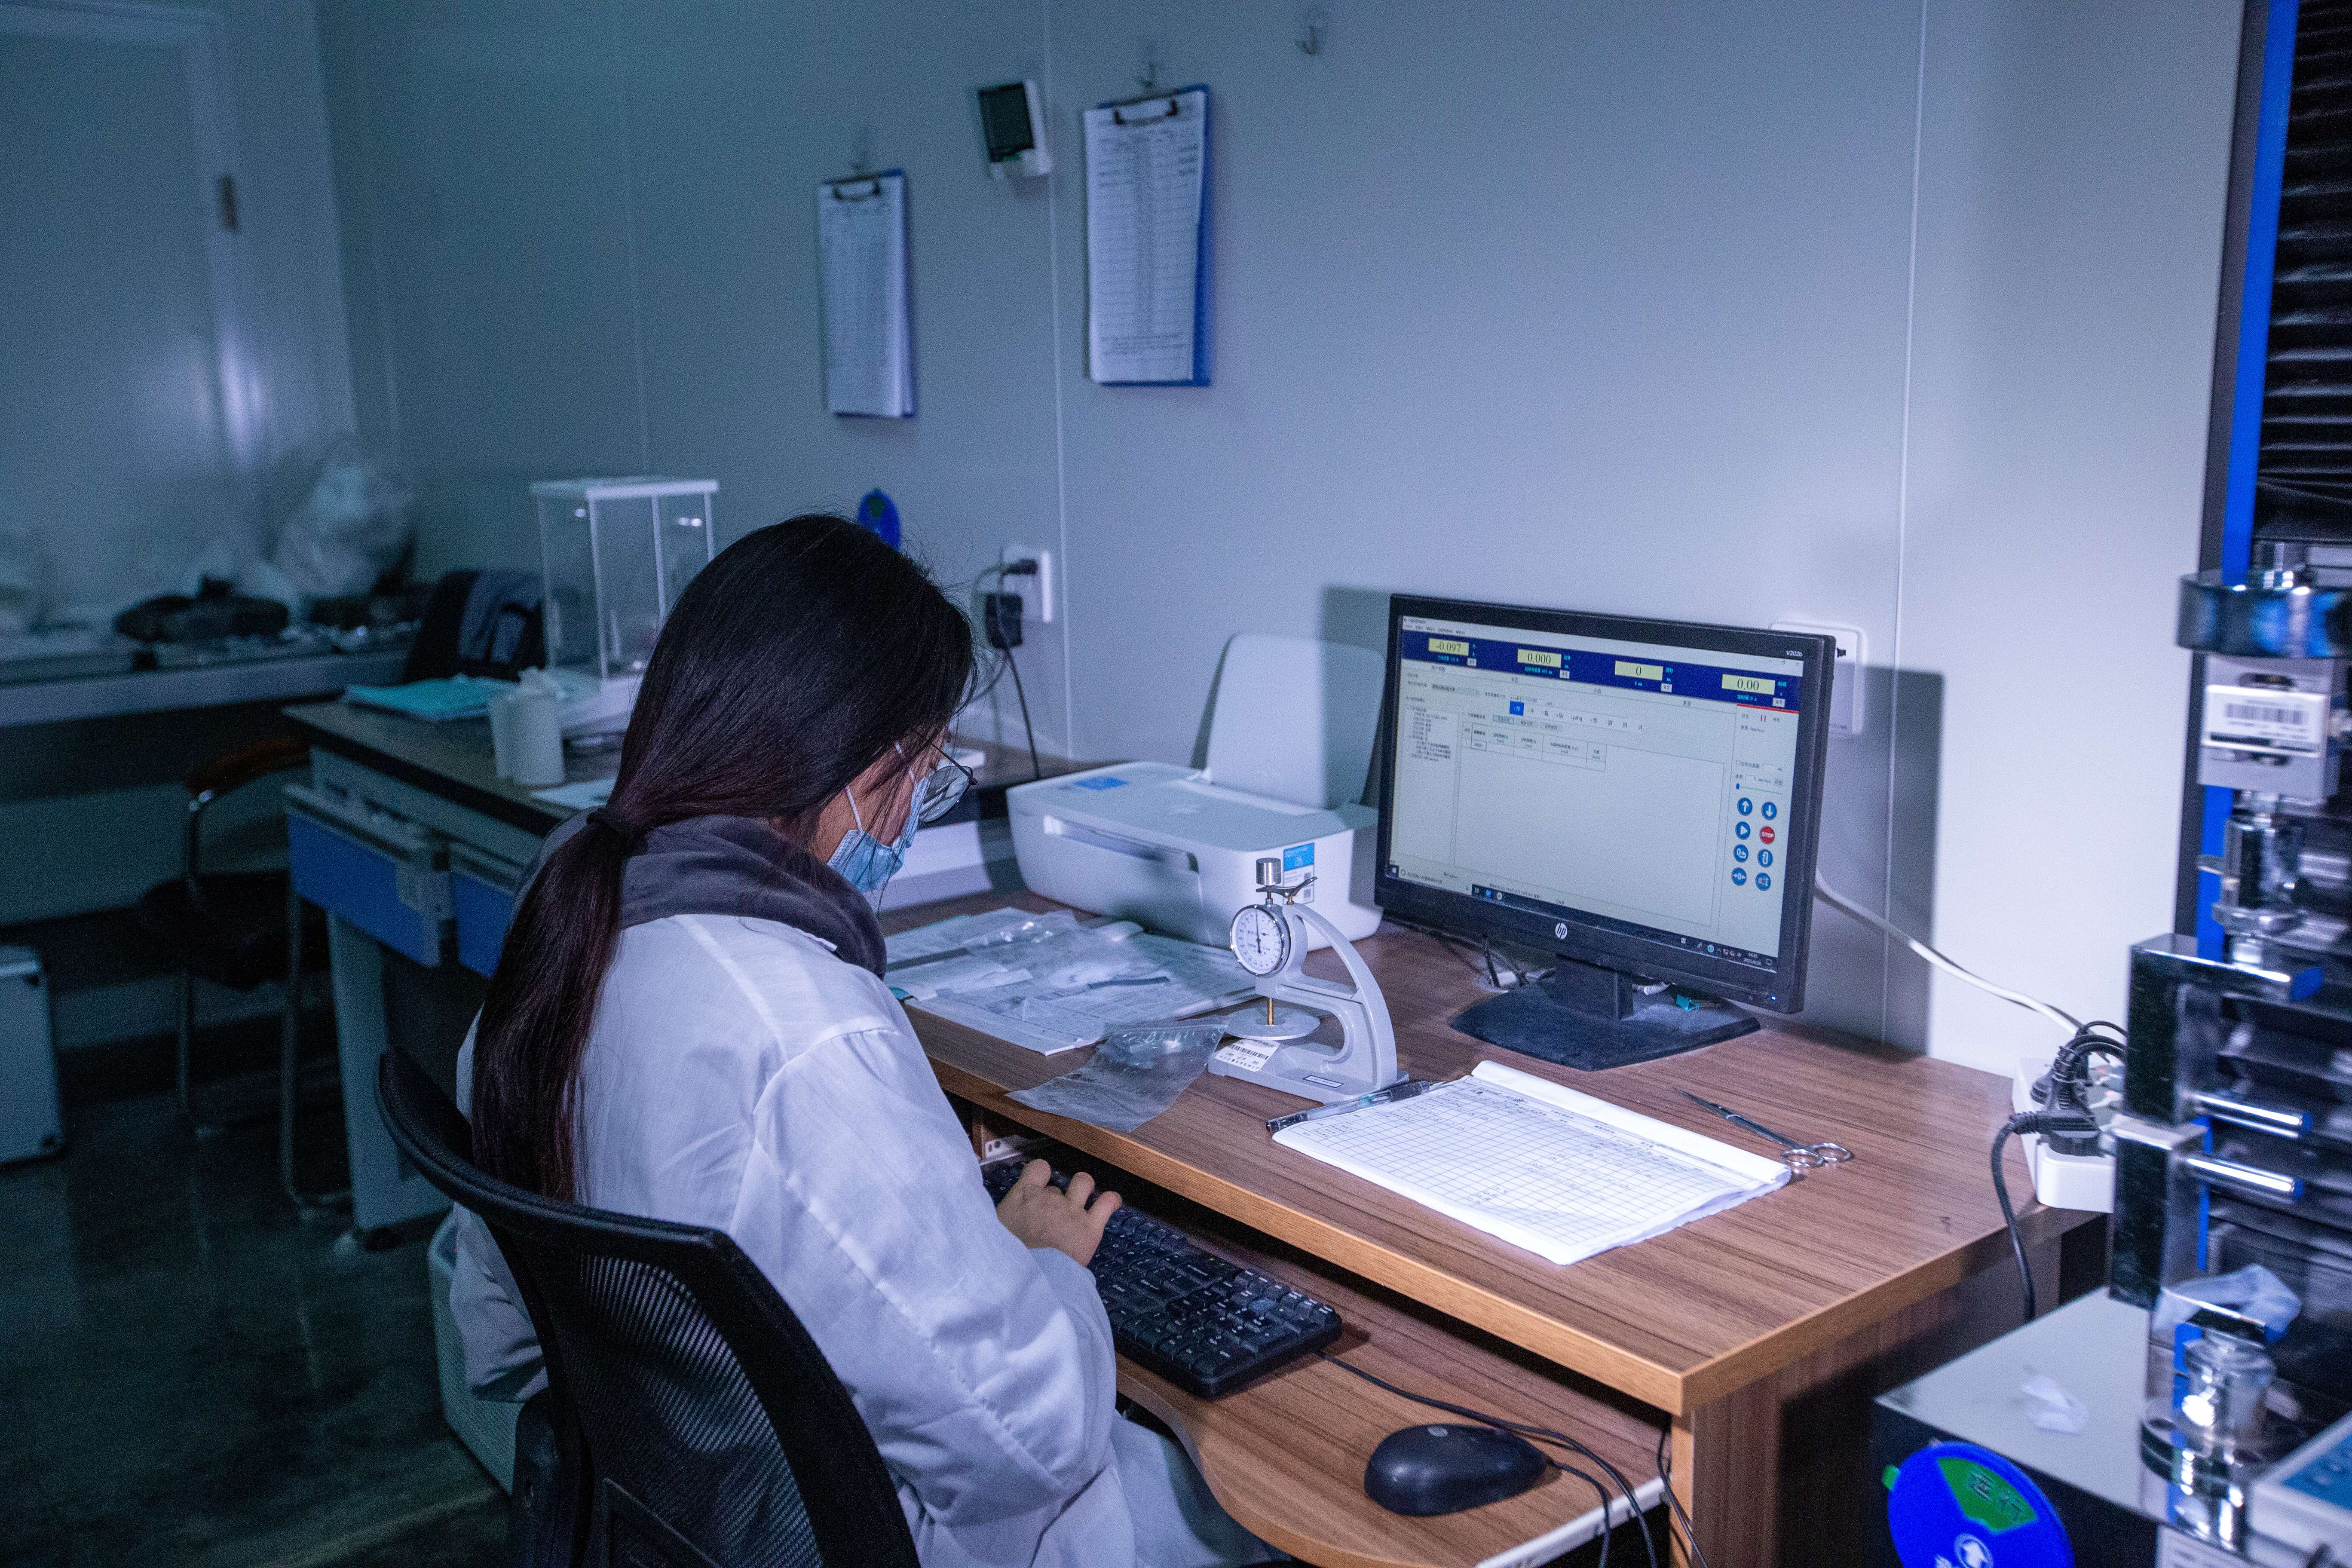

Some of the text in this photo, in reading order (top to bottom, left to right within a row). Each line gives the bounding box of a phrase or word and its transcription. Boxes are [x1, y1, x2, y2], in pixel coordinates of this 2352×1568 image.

[1436, 641, 1461, 653] -0.097
[1527, 652, 1551, 665] 0.000
[1635, 666, 1642, 676] 0
[1737, 677, 1759, 692] 0.00
[1556, 922, 1567, 940] hp
